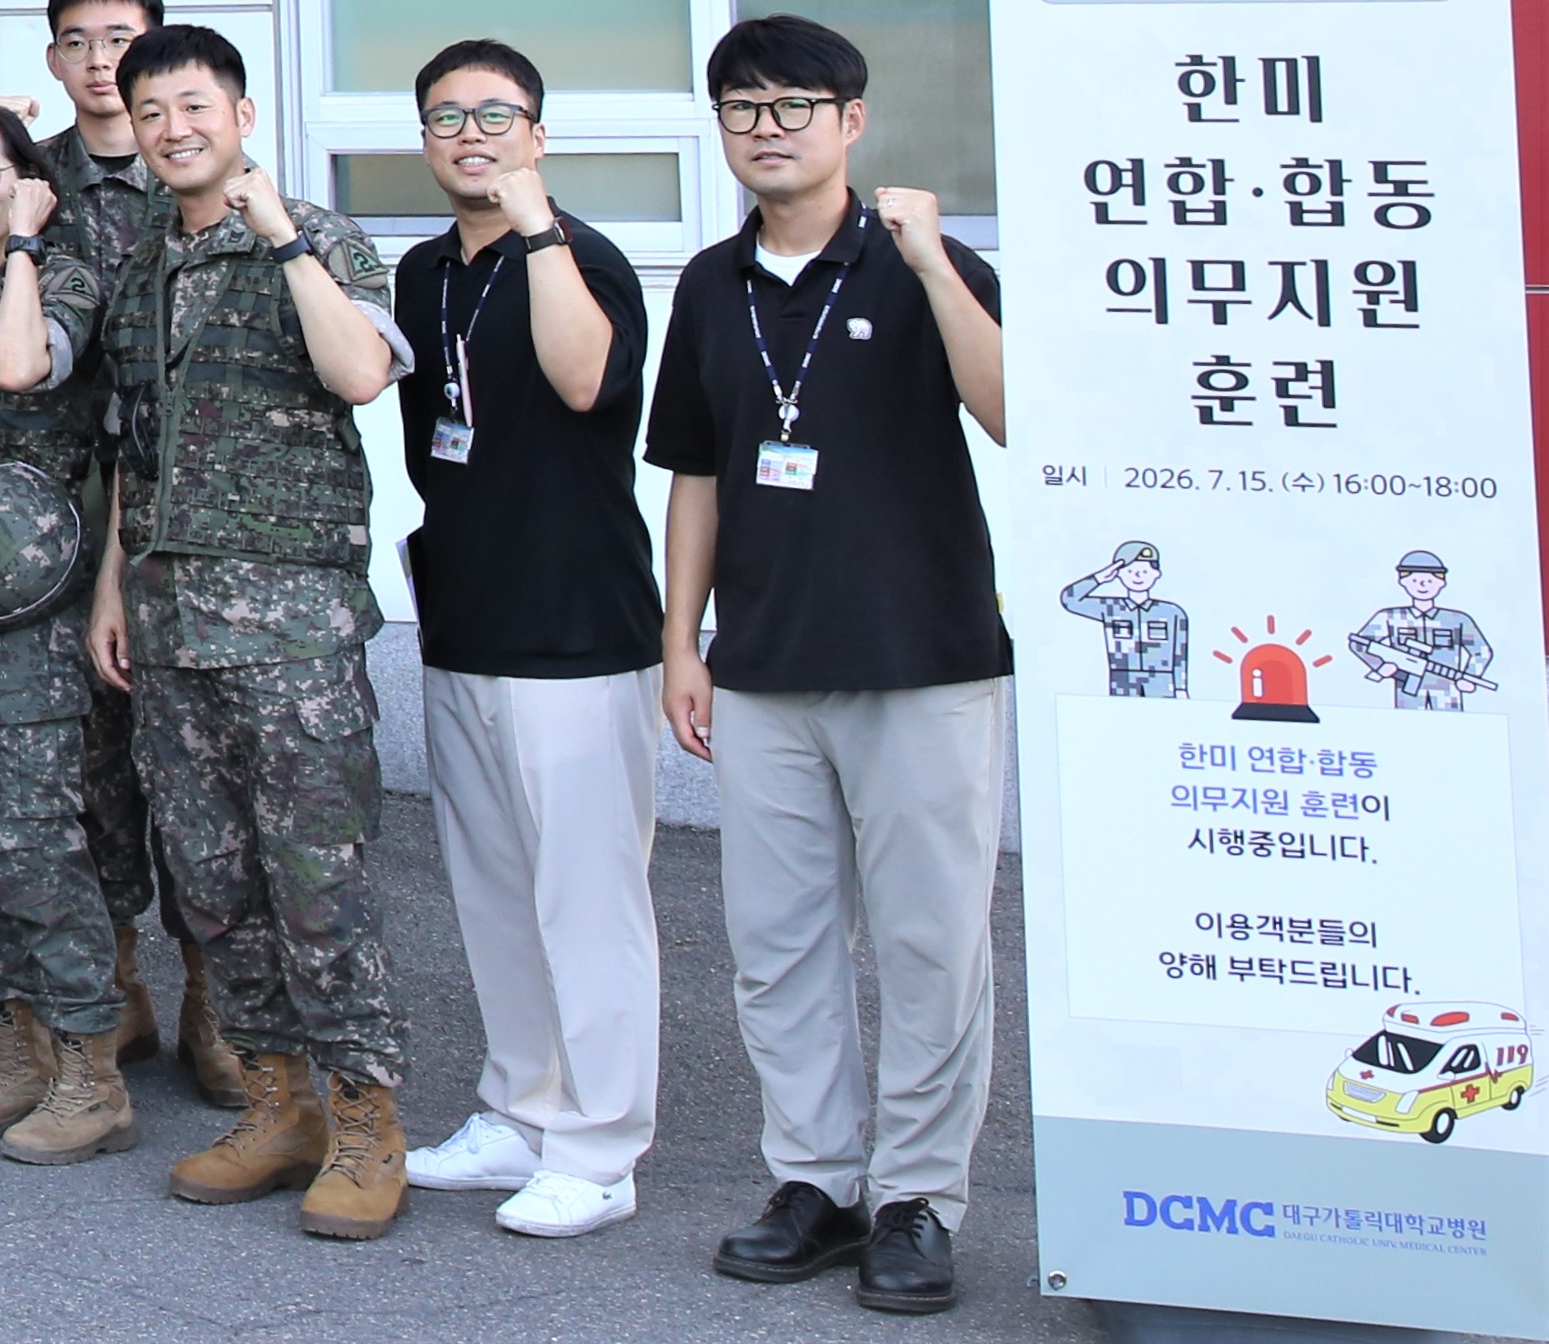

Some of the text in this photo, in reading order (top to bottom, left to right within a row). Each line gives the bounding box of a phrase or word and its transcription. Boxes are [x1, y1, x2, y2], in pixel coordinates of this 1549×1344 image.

[1174, 53, 1324, 125] 한미
[1082, 155, 1436, 231] 연합·합동
[353, 251, 376, 272] 2
[70, 277, 86, 294] 2
[1104, 256, 1422, 330] 의무지원
[1189, 354, 1339, 429] 훈련
[1041, 464, 1499, 499] 일시 2026. 7. 15. (수) 16:00~18:00
[1178, 742, 1378, 779] 한미 연합·합동
[1170, 784, 1391, 822] 의무지원 훈련이
[1187, 827, 1378, 865] 시행중입니다.
[1194, 911, 1378, 949] 이용객분들의
[1158, 951, 1421, 996] 양해 부탁드립니다.
[1495, 1043, 1530, 1067] 119
[1122, 1189, 1277, 1239] DCMC
[1281, 1203, 1488, 1242] 대구가톨릭대학교병원
[1283, 1230, 1319, 1243] DAEGU
[1319, 1234, 1370, 1247] CATHOLIC
[1400, 1241, 1446, 1254] MEDICAL
[1448, 1245, 1489, 1257] CENTER
